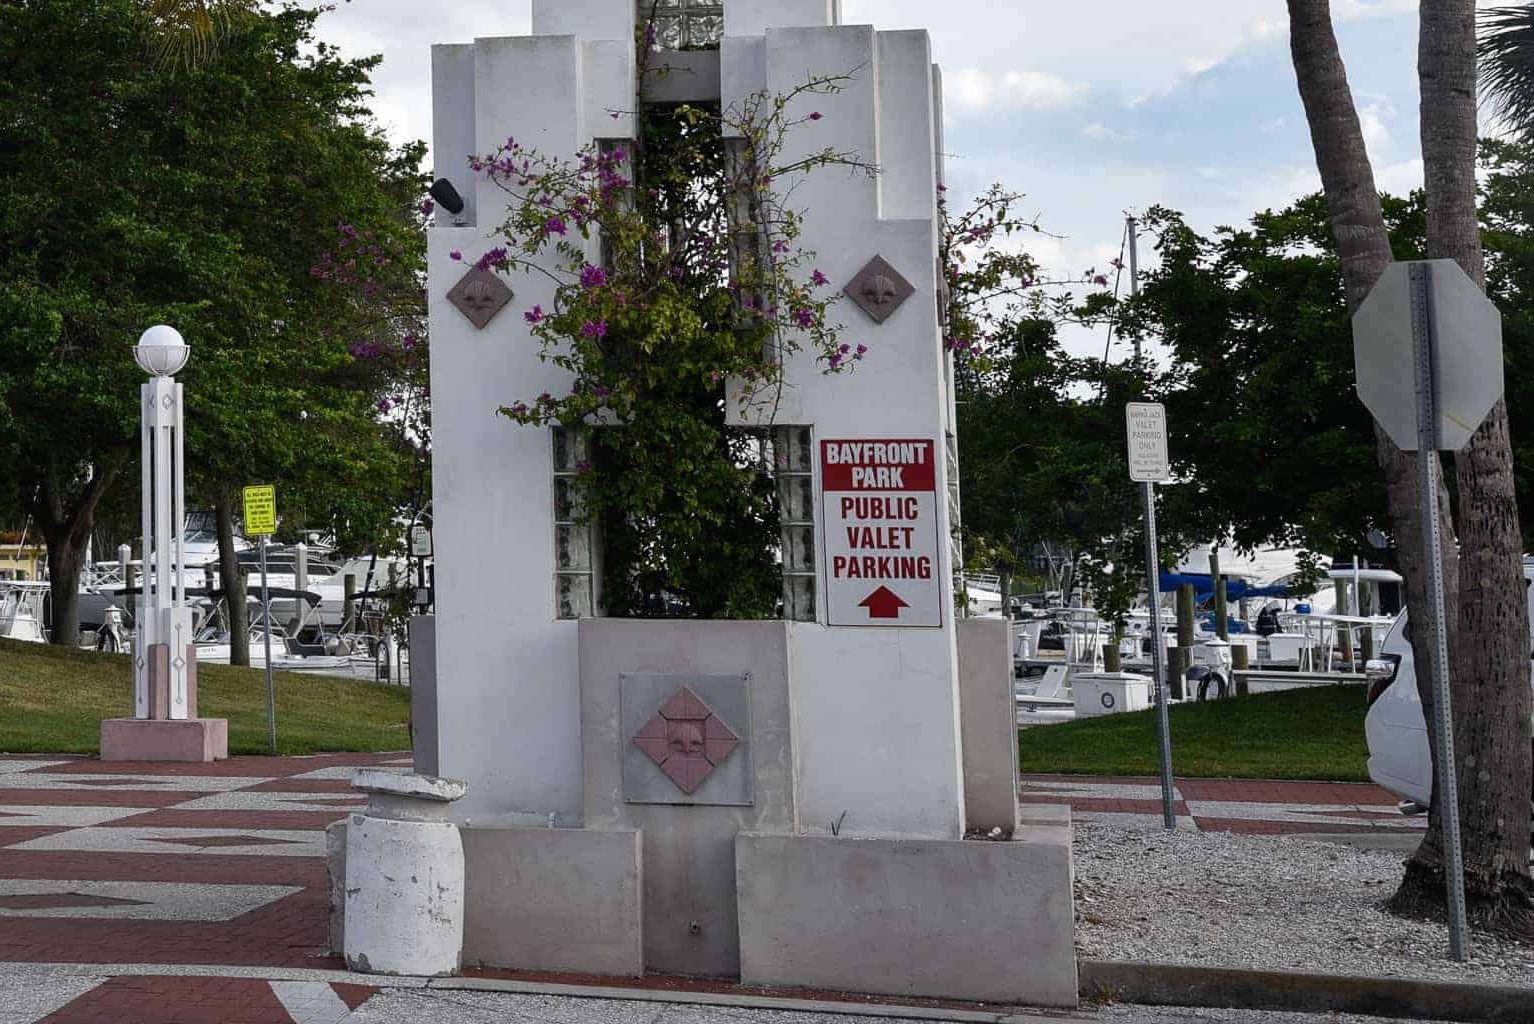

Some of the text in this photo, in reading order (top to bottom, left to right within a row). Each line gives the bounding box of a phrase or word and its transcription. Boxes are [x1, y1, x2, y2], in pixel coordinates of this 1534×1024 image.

[827, 443, 927, 464] BAYFRONT
[852, 467, 904, 488] PARK
[841, 497, 918, 520] PUBLIC
[847, 527, 914, 549] VALET
[833, 556, 931, 579] PARKING
